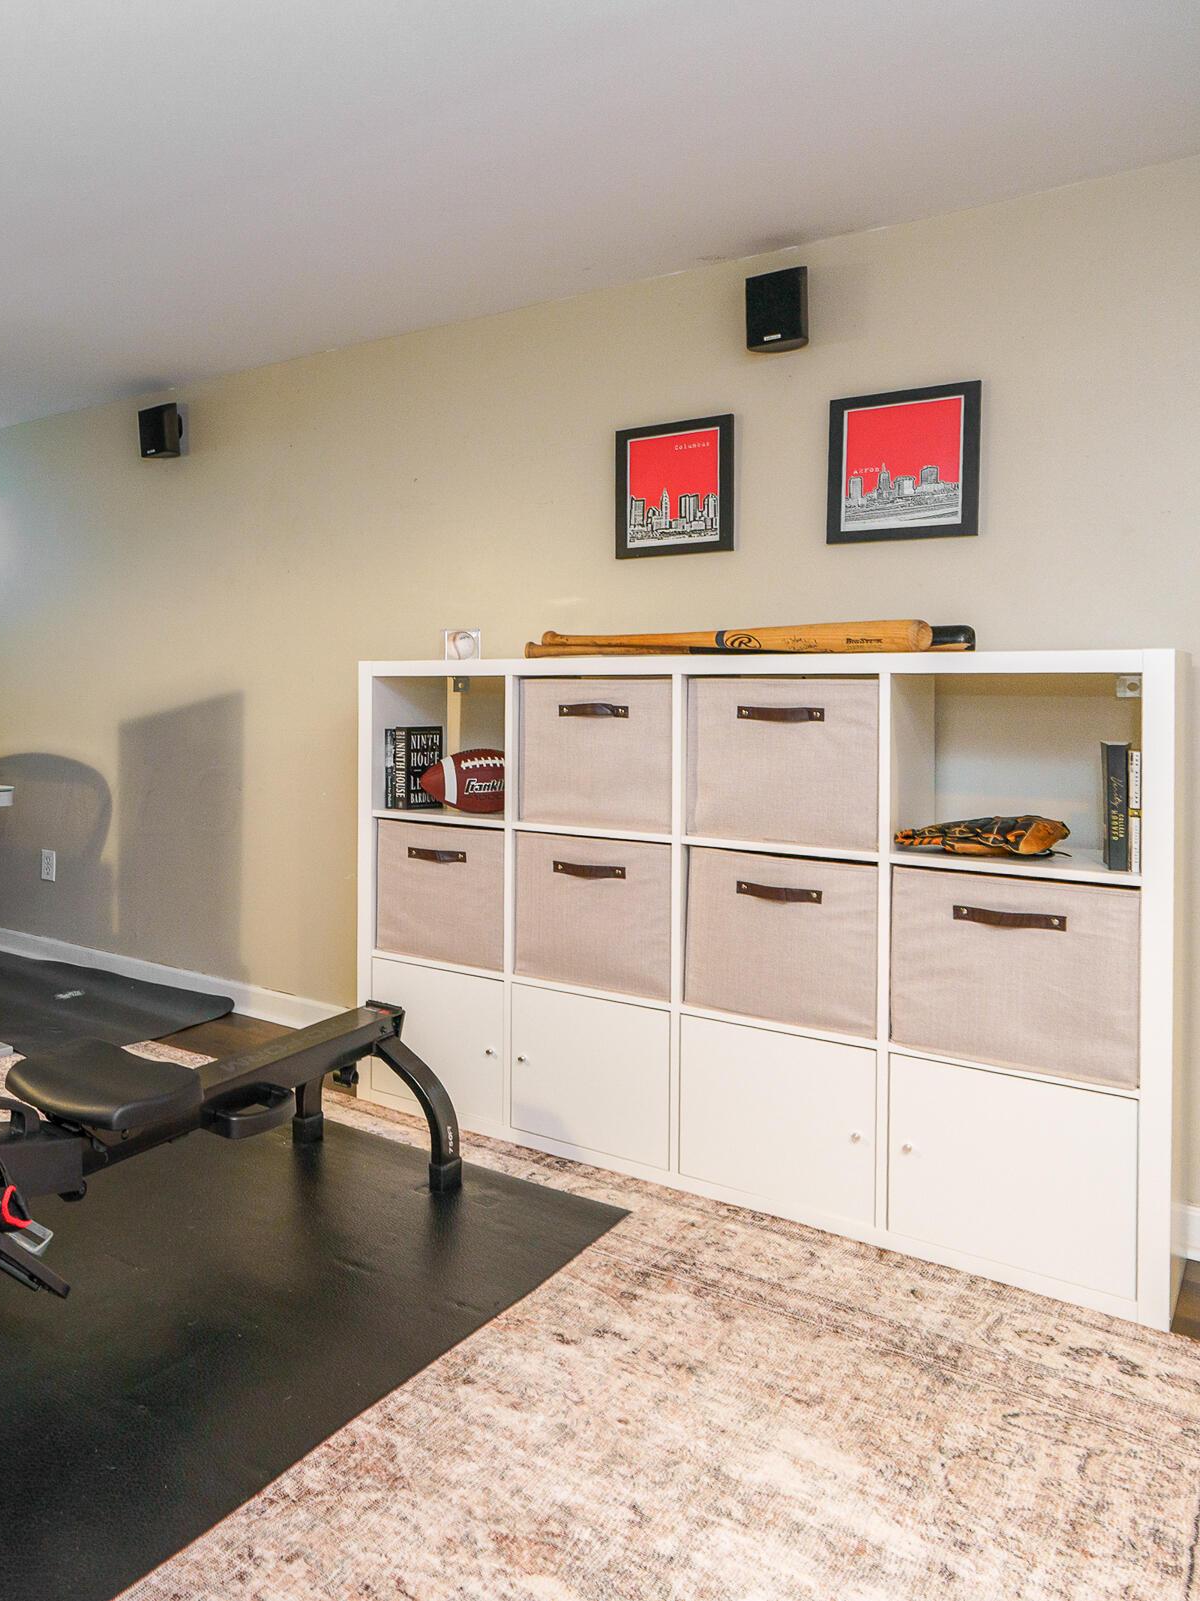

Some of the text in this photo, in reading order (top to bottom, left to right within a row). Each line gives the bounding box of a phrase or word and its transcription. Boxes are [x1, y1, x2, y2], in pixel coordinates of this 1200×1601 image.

[410, 734, 440, 750] NINTH
[395, 742, 406, 769] NINTH
[410, 751, 440, 767] HOUSE
[395, 770, 406, 798] HOUSE
[464, 778, 504, 794] Frankli
